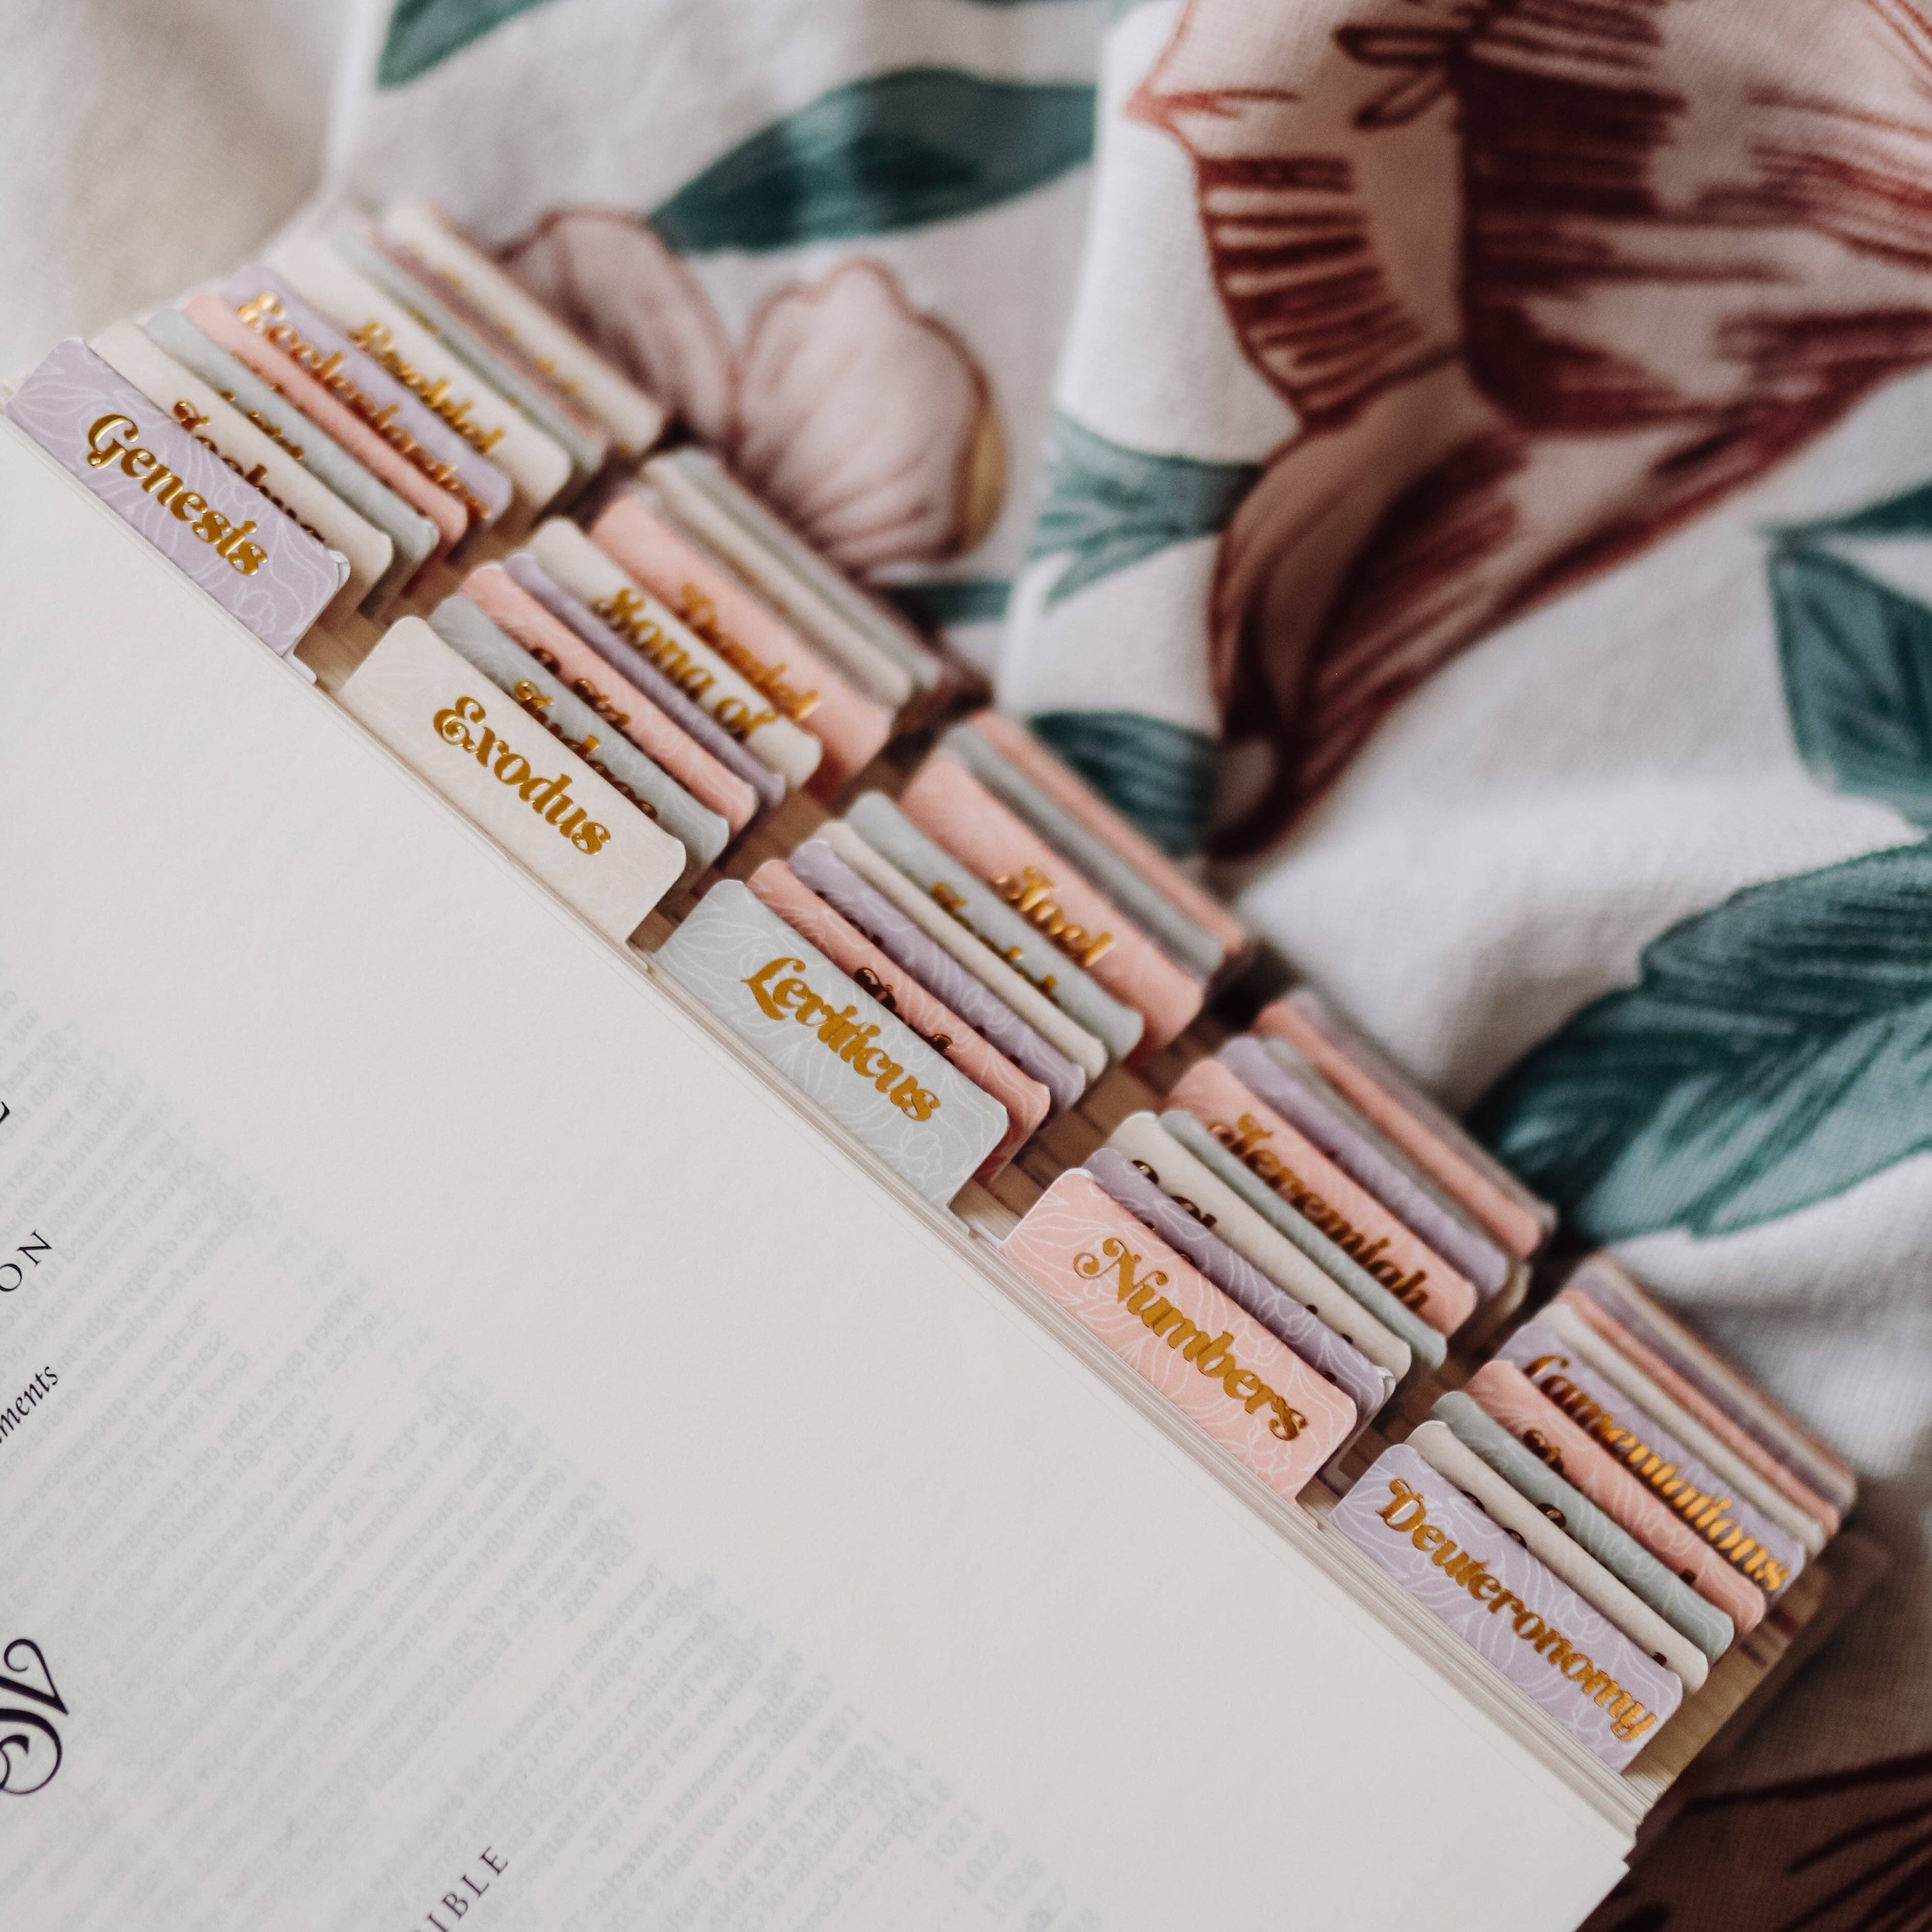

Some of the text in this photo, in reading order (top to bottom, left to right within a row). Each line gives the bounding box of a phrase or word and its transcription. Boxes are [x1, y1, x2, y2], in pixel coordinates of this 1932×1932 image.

[88, 414, 268, 576] Genesis
[433, 696, 610, 855] Exodus
[741, 957, 940, 1122] Leviticus
[1206, 1113, 1428, 1312] Jeremiah
[0, 1366, 58, 1443] ments
[1073, 1237, 1307, 1441] Numbers
[1376, 1478, 1657, 1743] Deuteronomy
[412, 1846, 508, 1932] IBLE
